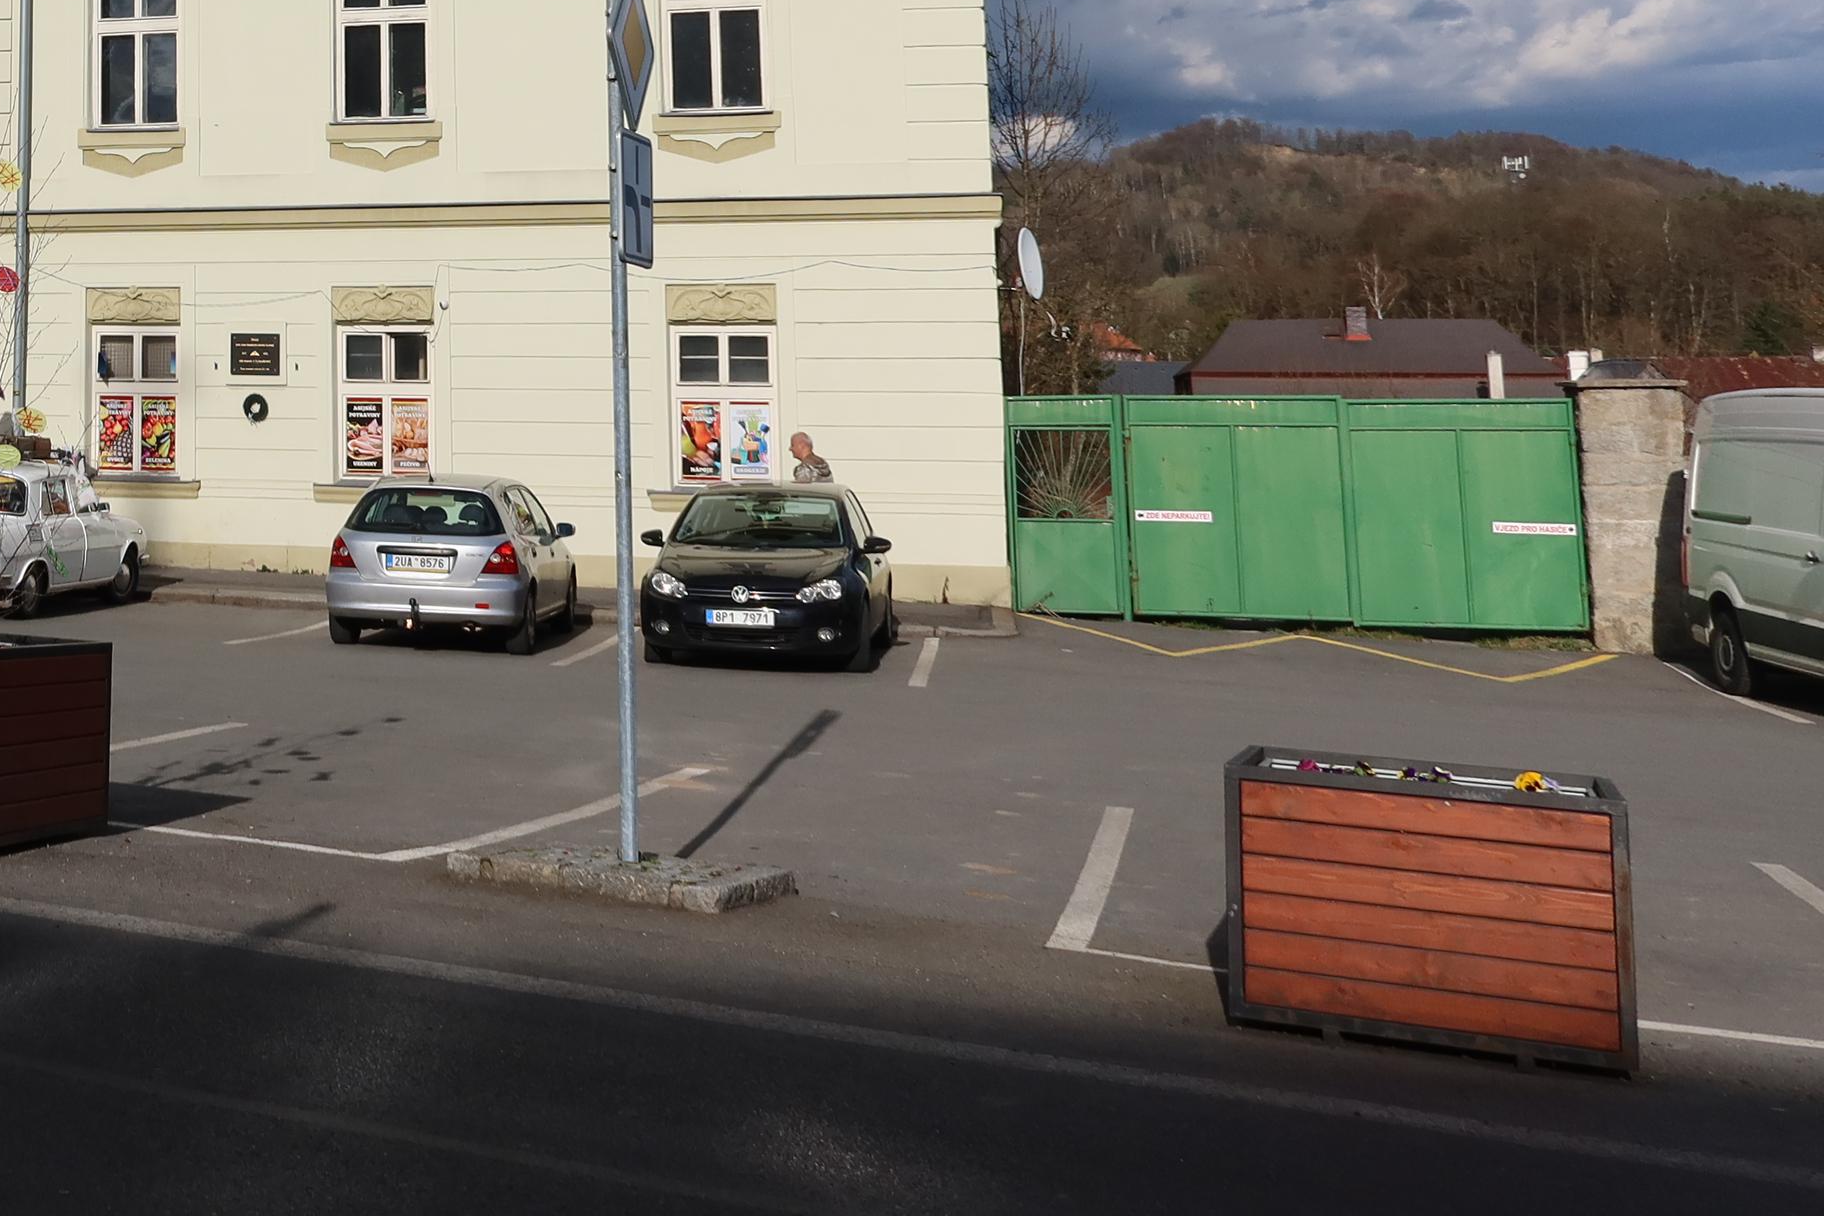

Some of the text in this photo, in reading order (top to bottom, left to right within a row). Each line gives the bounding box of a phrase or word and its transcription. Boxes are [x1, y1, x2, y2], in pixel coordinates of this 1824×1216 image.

[394, 557, 445, 568] 2UA 8576
[715, 612, 768, 624] 8P1 7971
